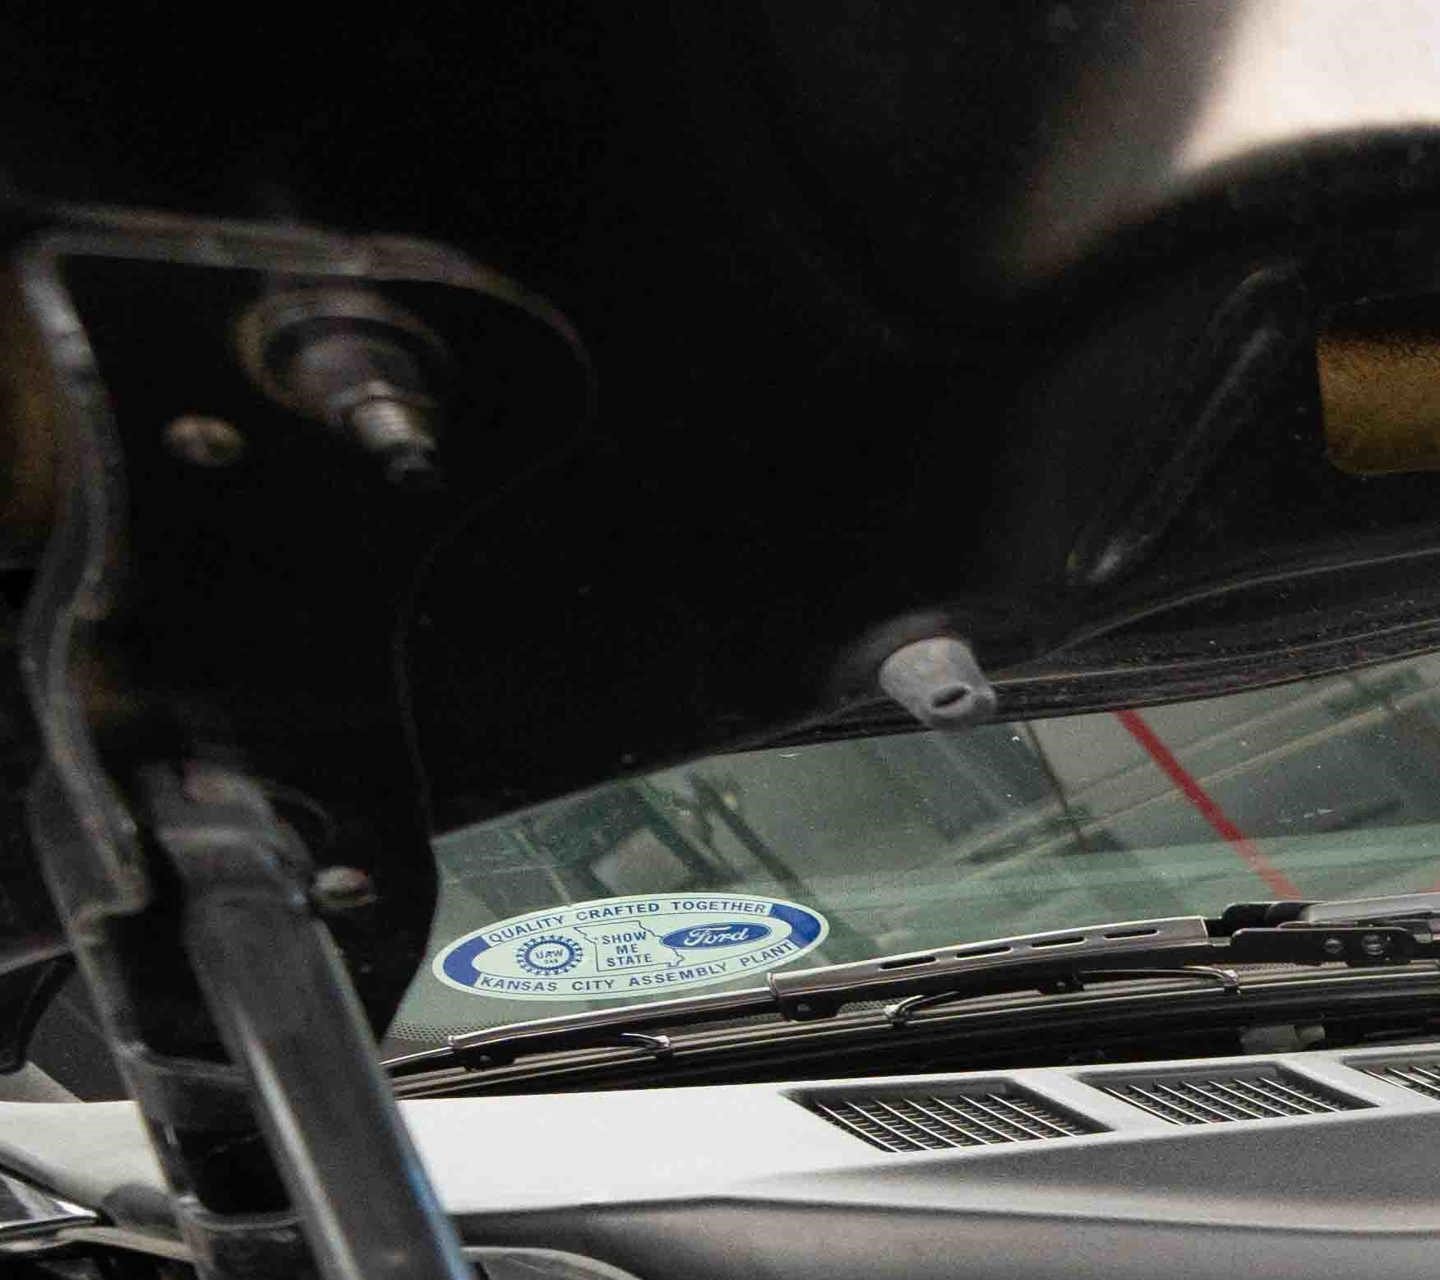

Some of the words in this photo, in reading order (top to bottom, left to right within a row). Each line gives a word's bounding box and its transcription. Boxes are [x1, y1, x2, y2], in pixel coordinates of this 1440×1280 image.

[488, 915, 564, 943] QUALITY
[576, 902, 660, 921] CRAFTED
[672, 900, 766, 914] TOGETHER
[602, 931, 647, 945] SHOW
[684, 925, 750, 947] Ford
[616, 944, 638, 955] ME
[481, 975, 558, 992] KANSAS
[572, 978, 615, 992] CITY
[629, 962, 728, 986] ASSEMBLY
[739, 941, 794, 967] PLANT
[606, 953, 653, 968] STATE
